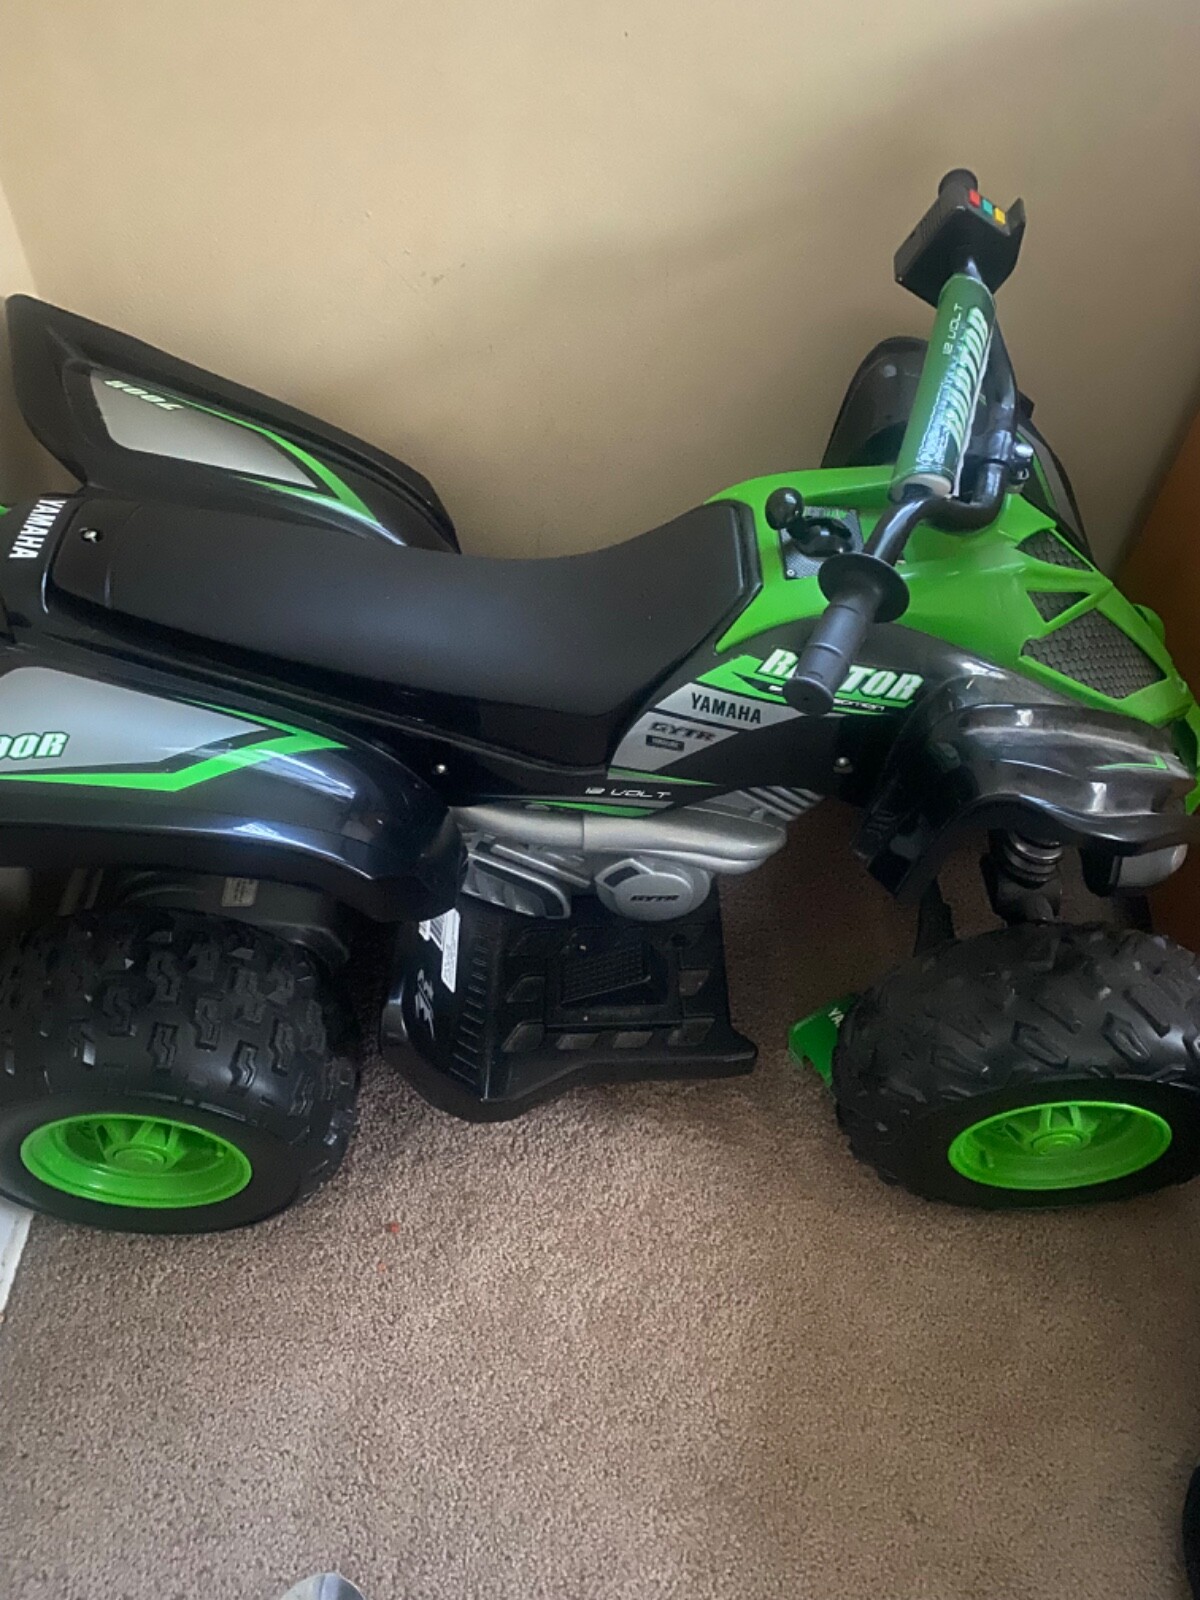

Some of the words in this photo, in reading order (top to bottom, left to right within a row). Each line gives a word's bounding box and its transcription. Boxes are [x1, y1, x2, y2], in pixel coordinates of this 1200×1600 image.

[9, 499, 67, 558] YAMAHA
[757, 648, 924, 701] RTOR
[691, 692, 761, 724] YAMAHA
[649, 721, 717, 741] GYTR
[610, 788, 672, 799] VOLT
